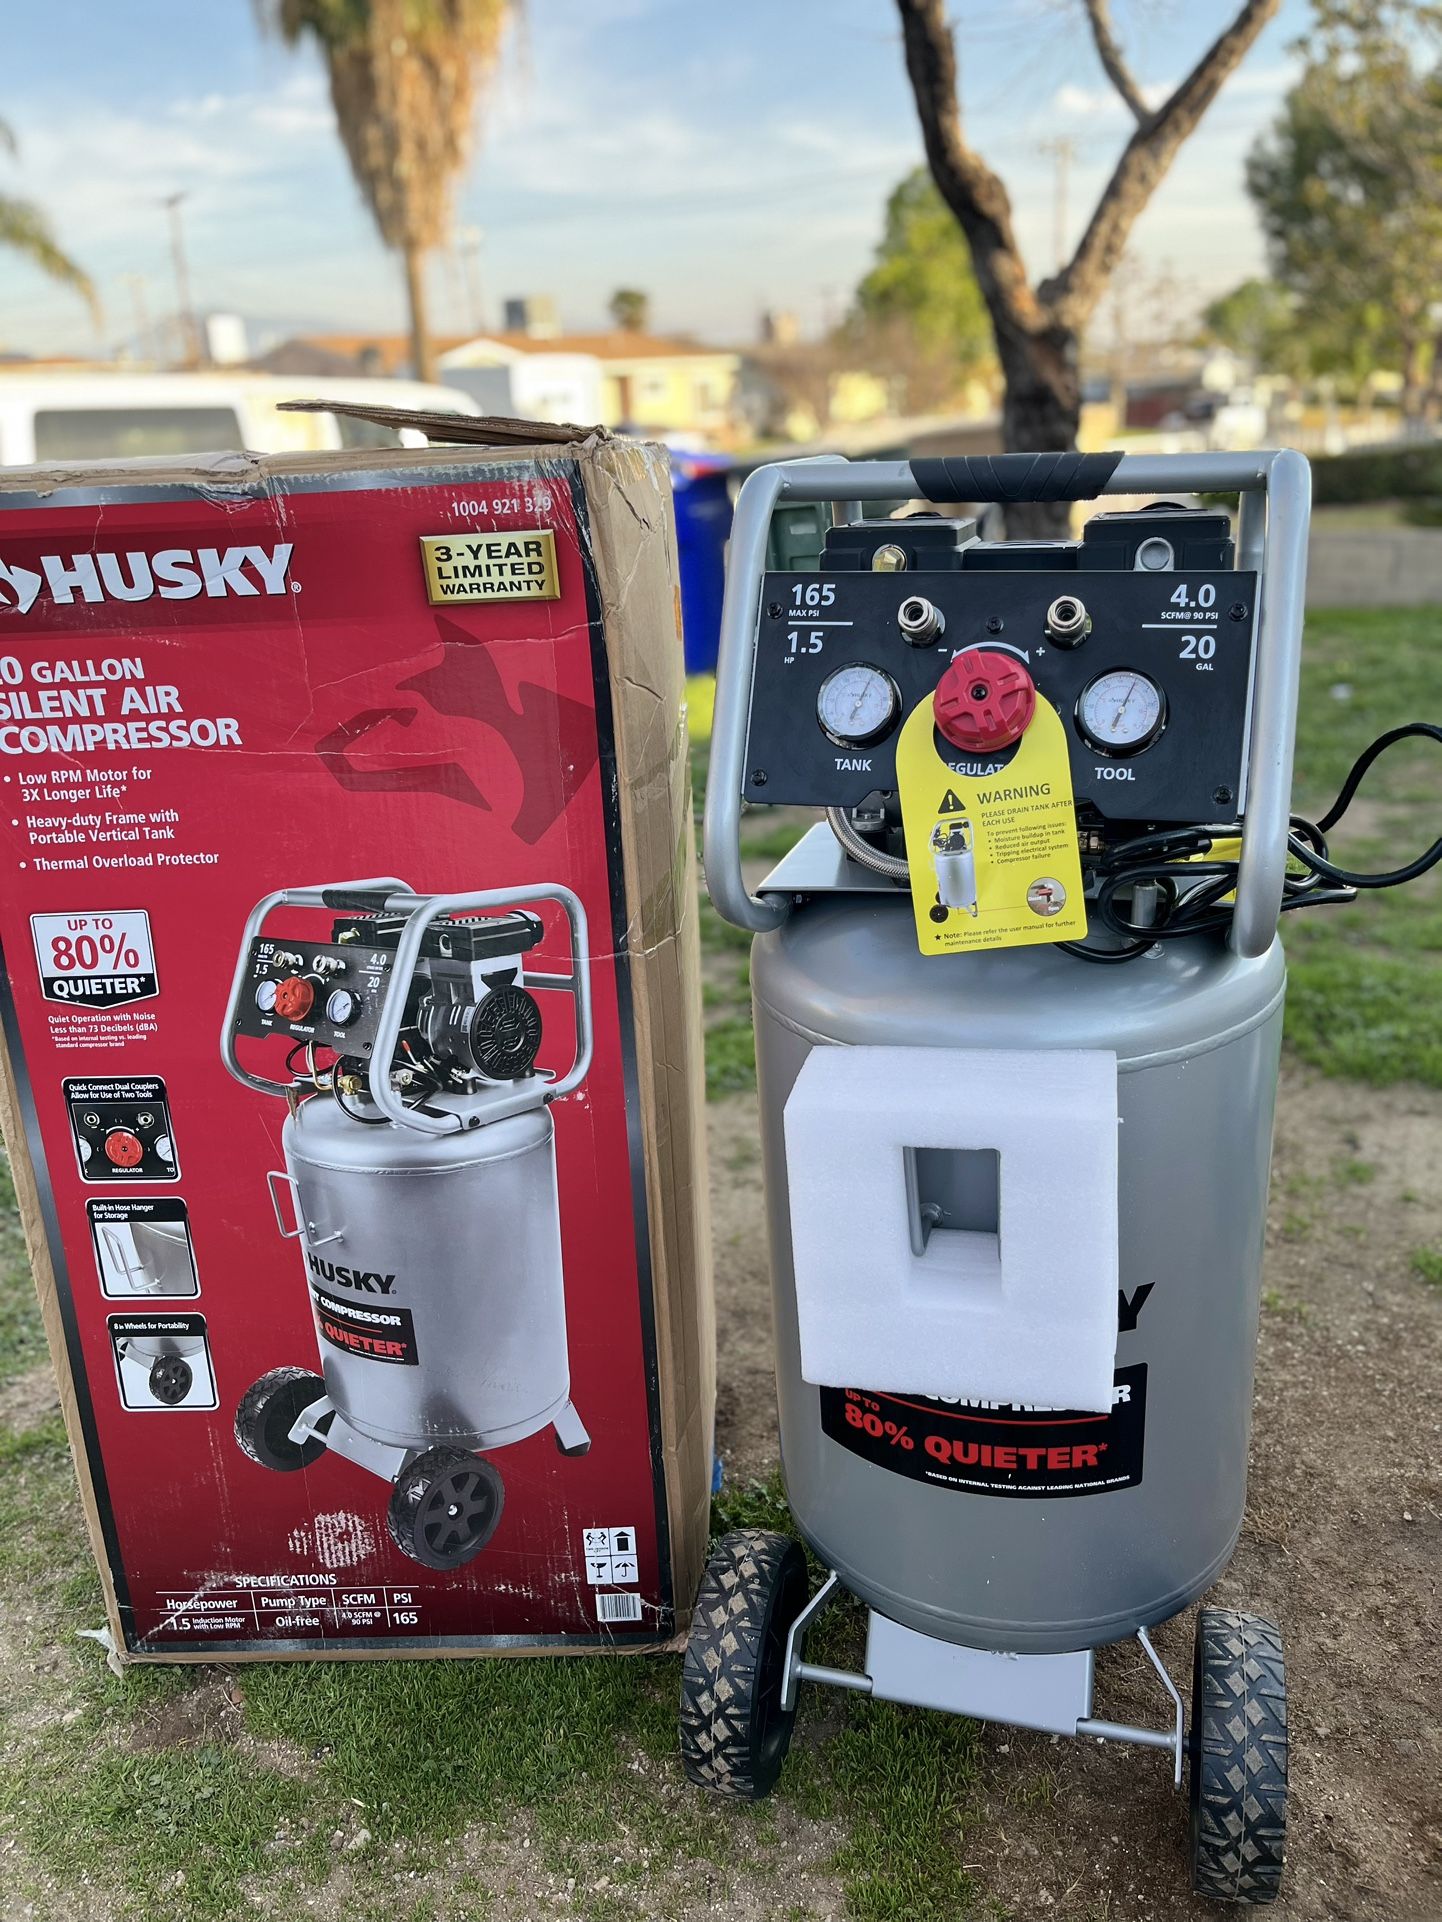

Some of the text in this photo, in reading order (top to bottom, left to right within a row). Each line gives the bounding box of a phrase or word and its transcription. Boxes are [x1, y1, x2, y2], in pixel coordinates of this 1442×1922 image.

[451, 501, 488, 516] 1004
[493, 499, 520, 514] 921
[434, 540, 543, 562] 3-YEAR
[436, 561, 545, 580] LIMITED
[440, 579, 546, 596] WARRANTY
[791, 583, 836, 606] 165
[1170, 583, 1216, 608] 4.0
[788, 609, 820, 617] MAX PSI
[1193, 612, 1204, 620] 90
[1205, 611, 1219, 620] PSI
[787, 631, 824, 654] 1.5
[1179, 635, 1216, 659] 20
[784, 656, 795, 664] HP
[1195, 662, 1214, 671] GAL
[0, 656, 145, 685] 0 GALLON
[0, 685, 184, 720] SILENT AIR
[0, 717, 243, 755] COMPRESSOR
[834, 758, 873, 772] TANK
[948, 762, 1004, 775] EGULAT
[18, 766, 152, 786] Low RPM Motor for
[1095, 767, 1136, 781] TOOL
[22, 788, 40, 802] 3X
[44, 786, 91, 803] Longer
[976, 783, 1051, 805] WARNING
[981, 799, 1073, 818] PLEASE DRAIN TANK AFTER
[26, 808, 179, 830] Heavy-duty Frame with
[982, 816, 1015, 827] EACH USE
[29, 825, 175, 845] Portable Vertical Tank
[995, 828, 1018, 836] prevent
[1019, 824, 1047, 832] following
[994, 834, 1020, 843] Moisture
[995, 842, 1020, 850] Reduced
[996, 843, 1069, 858] Tripping electrical system
[33, 851, 219, 871] Thermal Overload Protector
[996, 852, 1051, 864] Compressor failure
[67, 918, 113, 931] UP TO
[943, 931, 962, 940] Note:
[944, 938, 982, 947] maintenance
[50, 932, 140, 972] 80%
[260, 943, 275, 955] 165
[370, 953, 387, 966] 4.0
[255, 963, 269, 975] 1.5
[367, 976, 380, 988] 20
[48, 1012, 156, 1024] Quiet Operation with Noise
[50, 1022, 158, 1034] Less than 73 Decibels (dBA)
[69, 1083, 87, 1091] Quick
[88, 1083, 114, 1091] Connect
[130, 1082, 159, 1091] Couplers
[70, 1091, 89, 1099] Allow
[131, 1204, 154, 1212] Hanger
[104, 1212, 128, 1220] Storage
[320, 1296, 402, 1326] COMPRESSOR
[124, 1322, 147, 1330] Wheels
[157, 1322, 190, 1331] Portability
[845, 1387, 880, 1412] UP TO
[844, 1402, 914, 1450] 80%
[958, 1478, 990, 1488] INTERNAL
[1074, 1480, 1106, 1489] NATIONAL
[1106, 1474, 1131, 1484] BRANDS
[235, 1573, 337, 1588] SPECIFICATIONS
[166, 1592, 412, 1612] Horsepower Pump Type SCFM PSI
[171, 1611, 418, 1631] 1.5 Oil-free 165
[351, 1618, 361, 1626] 90
